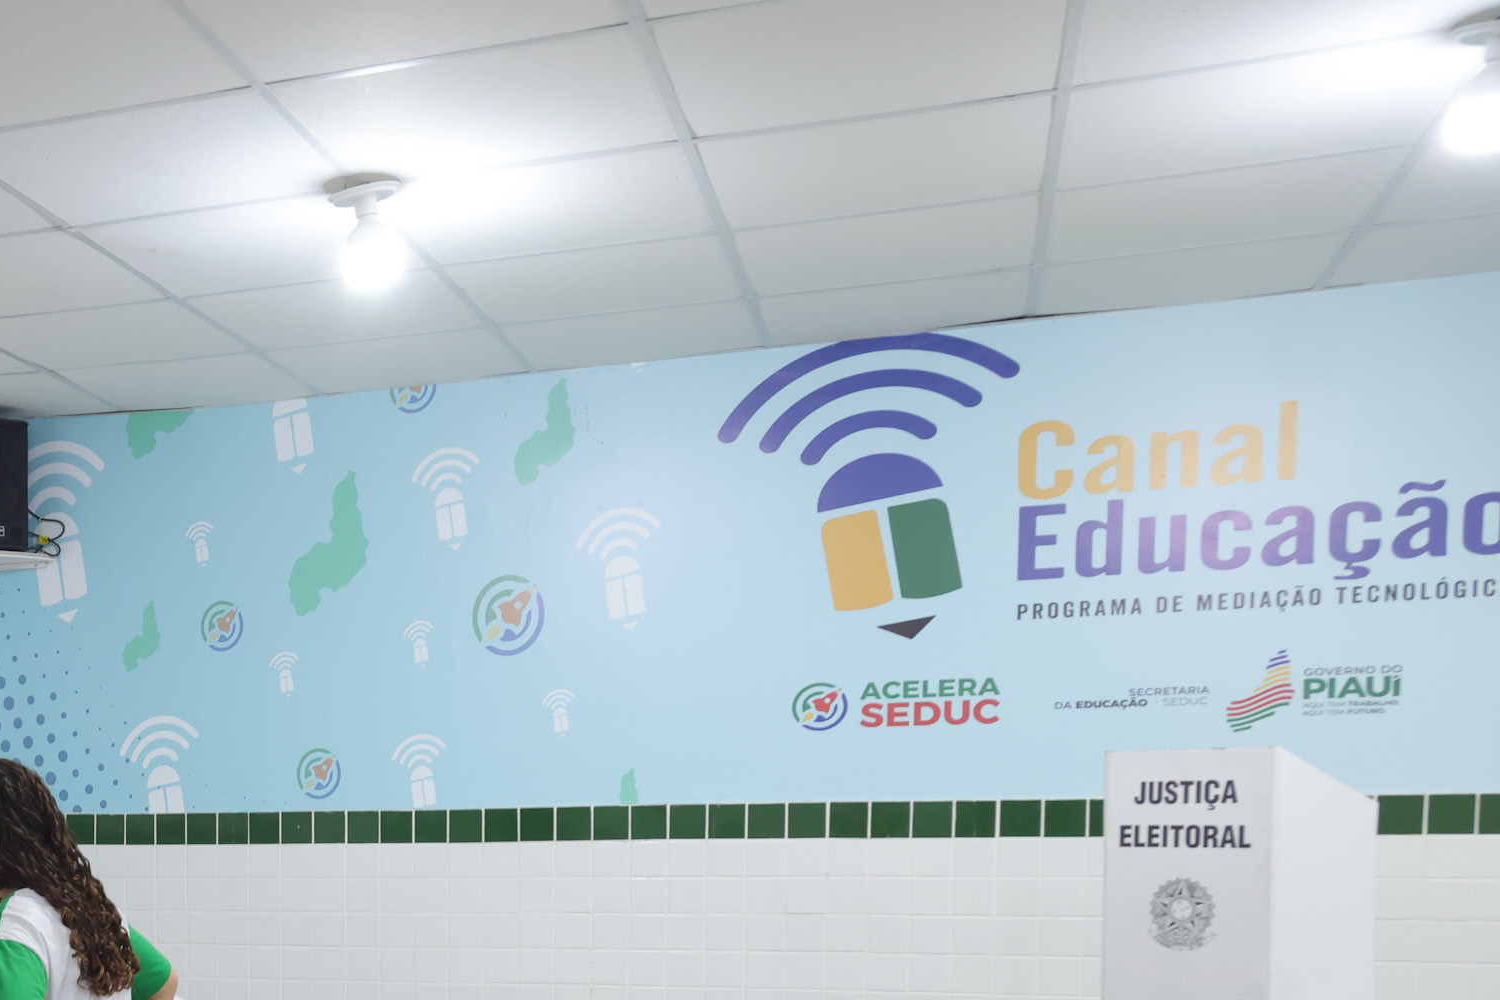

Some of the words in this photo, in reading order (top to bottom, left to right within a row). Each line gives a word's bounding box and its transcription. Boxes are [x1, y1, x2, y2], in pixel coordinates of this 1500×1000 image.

[1017, 400, 1298, 500] Canal
[1017, 479, 1500, 581] Educação
[1016, 597, 1142, 621] PROGRAMA
[1155, 595, 1184, 614] DE
[1196, 585, 1323, 613] MEDIAÇÃO
[1336, 576, 1500, 605] TECNOLÓGIC
[1303, 665, 1377, 677] GOVERNO
[1380, 664, 1404, 674] DO
[859, 677, 1000, 700] ACELERA
[1128, 686, 1210, 697] SECRETARIA
[1302, 674, 1402, 700] PIAUÍ
[859, 699, 1000, 728] SEDUC
[1054, 701, 1073, 710] DA
[1076, 697, 1149, 710] EDUCAÇÃO
[1162, 696, 1208, 707] SEDUC
[1134, 779, 1239, 811] JUSTIÇA
[1118, 824, 1252, 849] ELEITORAL
